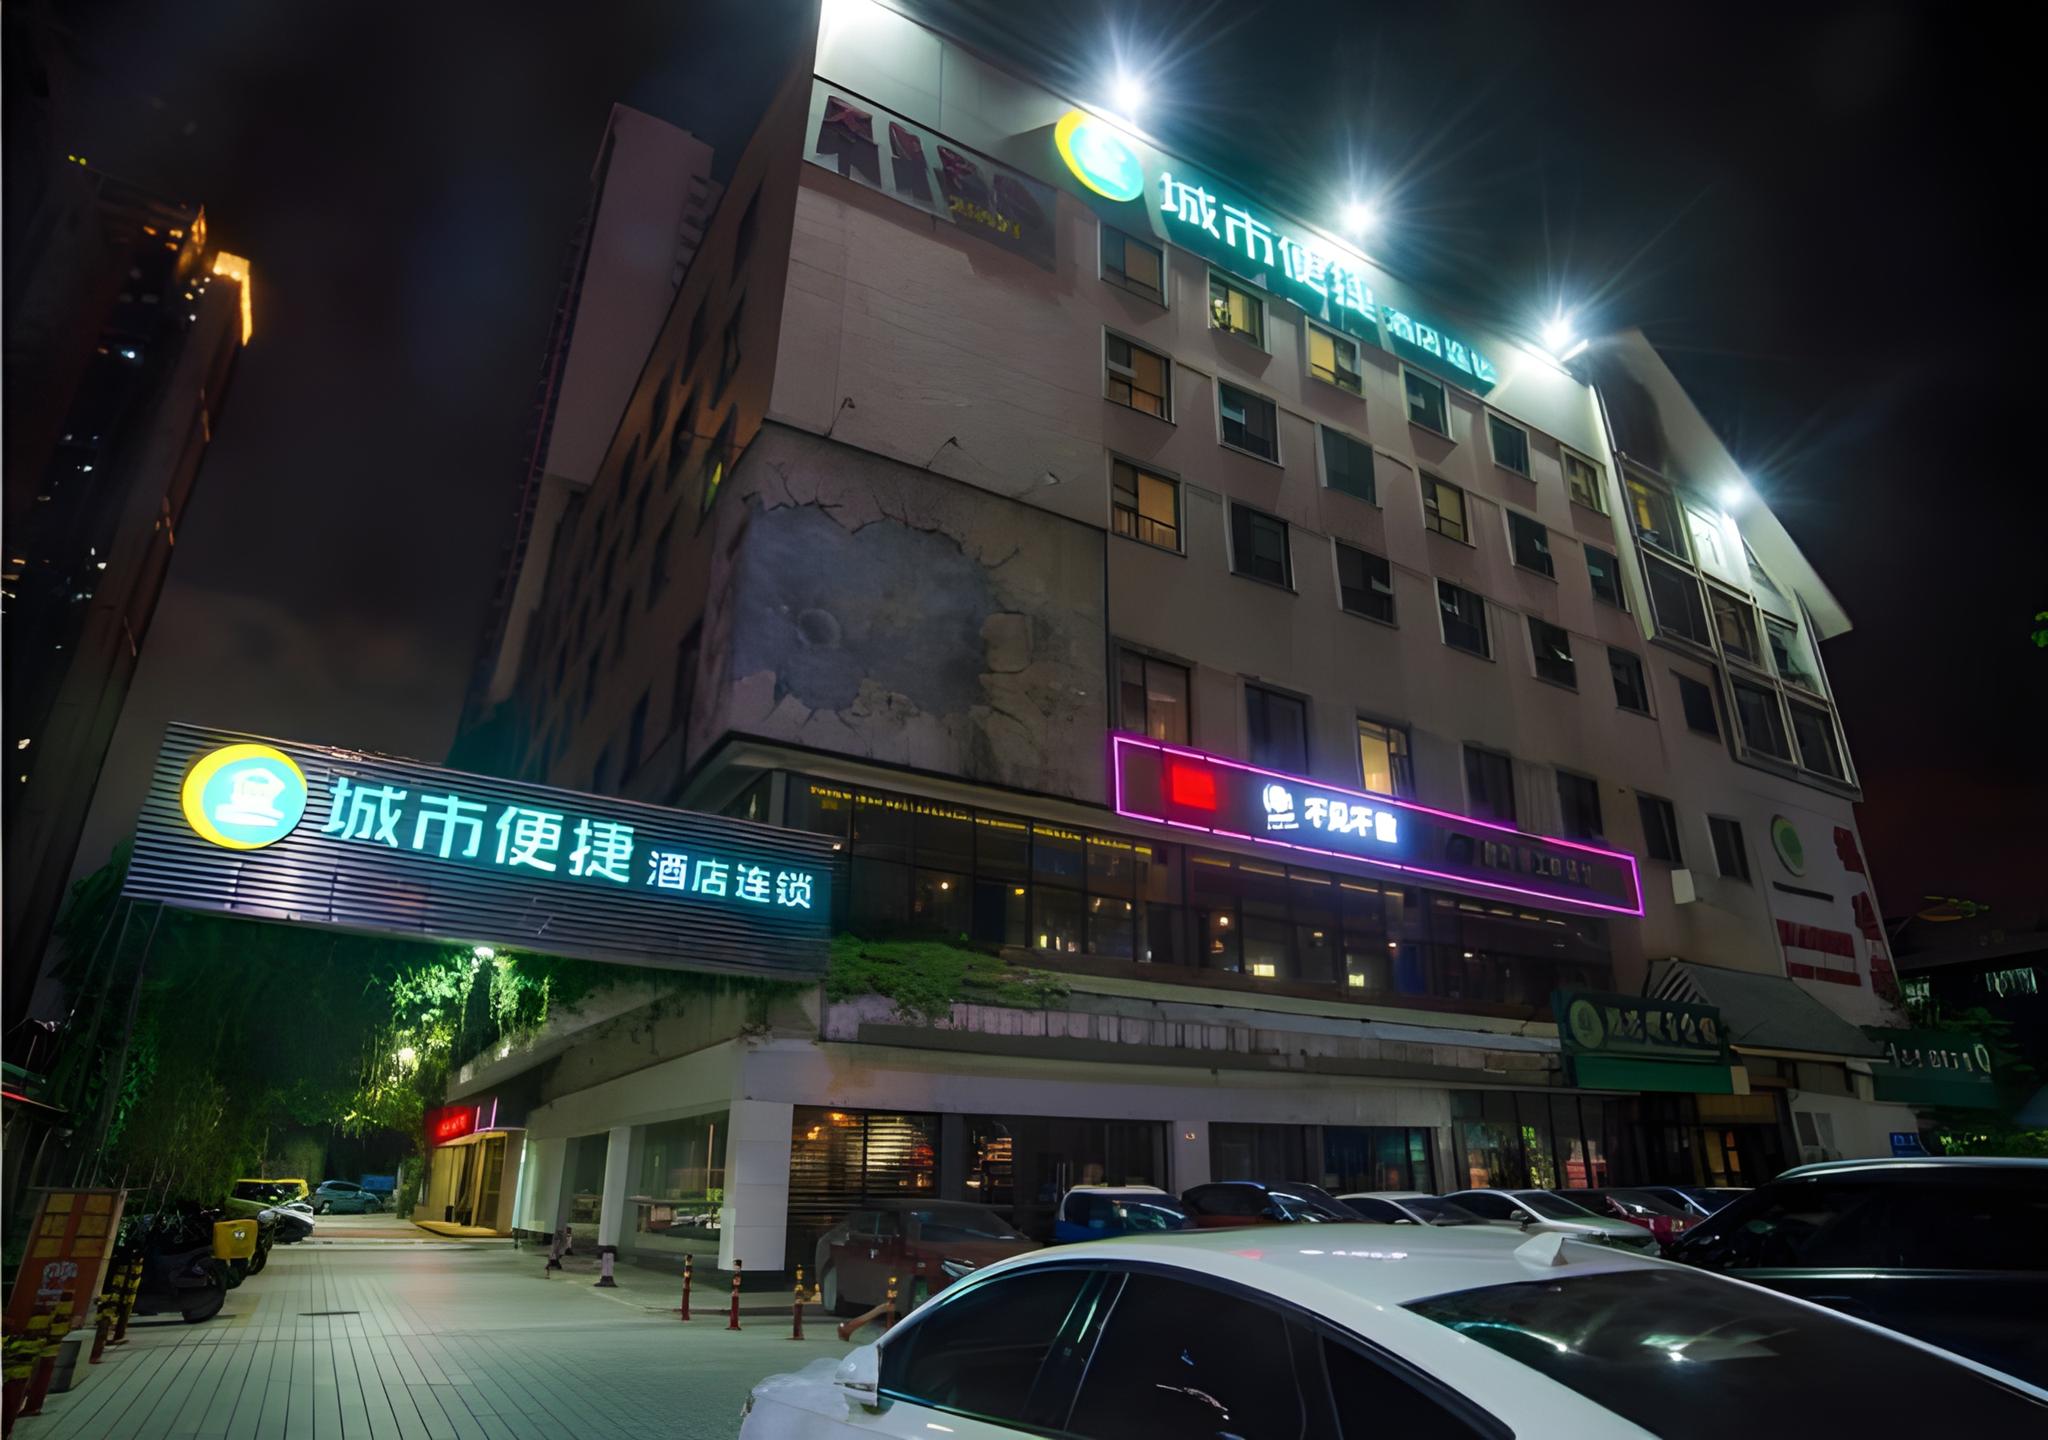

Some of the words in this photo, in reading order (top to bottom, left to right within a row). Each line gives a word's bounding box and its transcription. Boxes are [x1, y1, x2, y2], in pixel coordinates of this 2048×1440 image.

[320, 776, 636, 884] 城市便捷
[1303, 796, 1398, 844] 不见不
[646, 850, 813, 909] 酒店连锁
